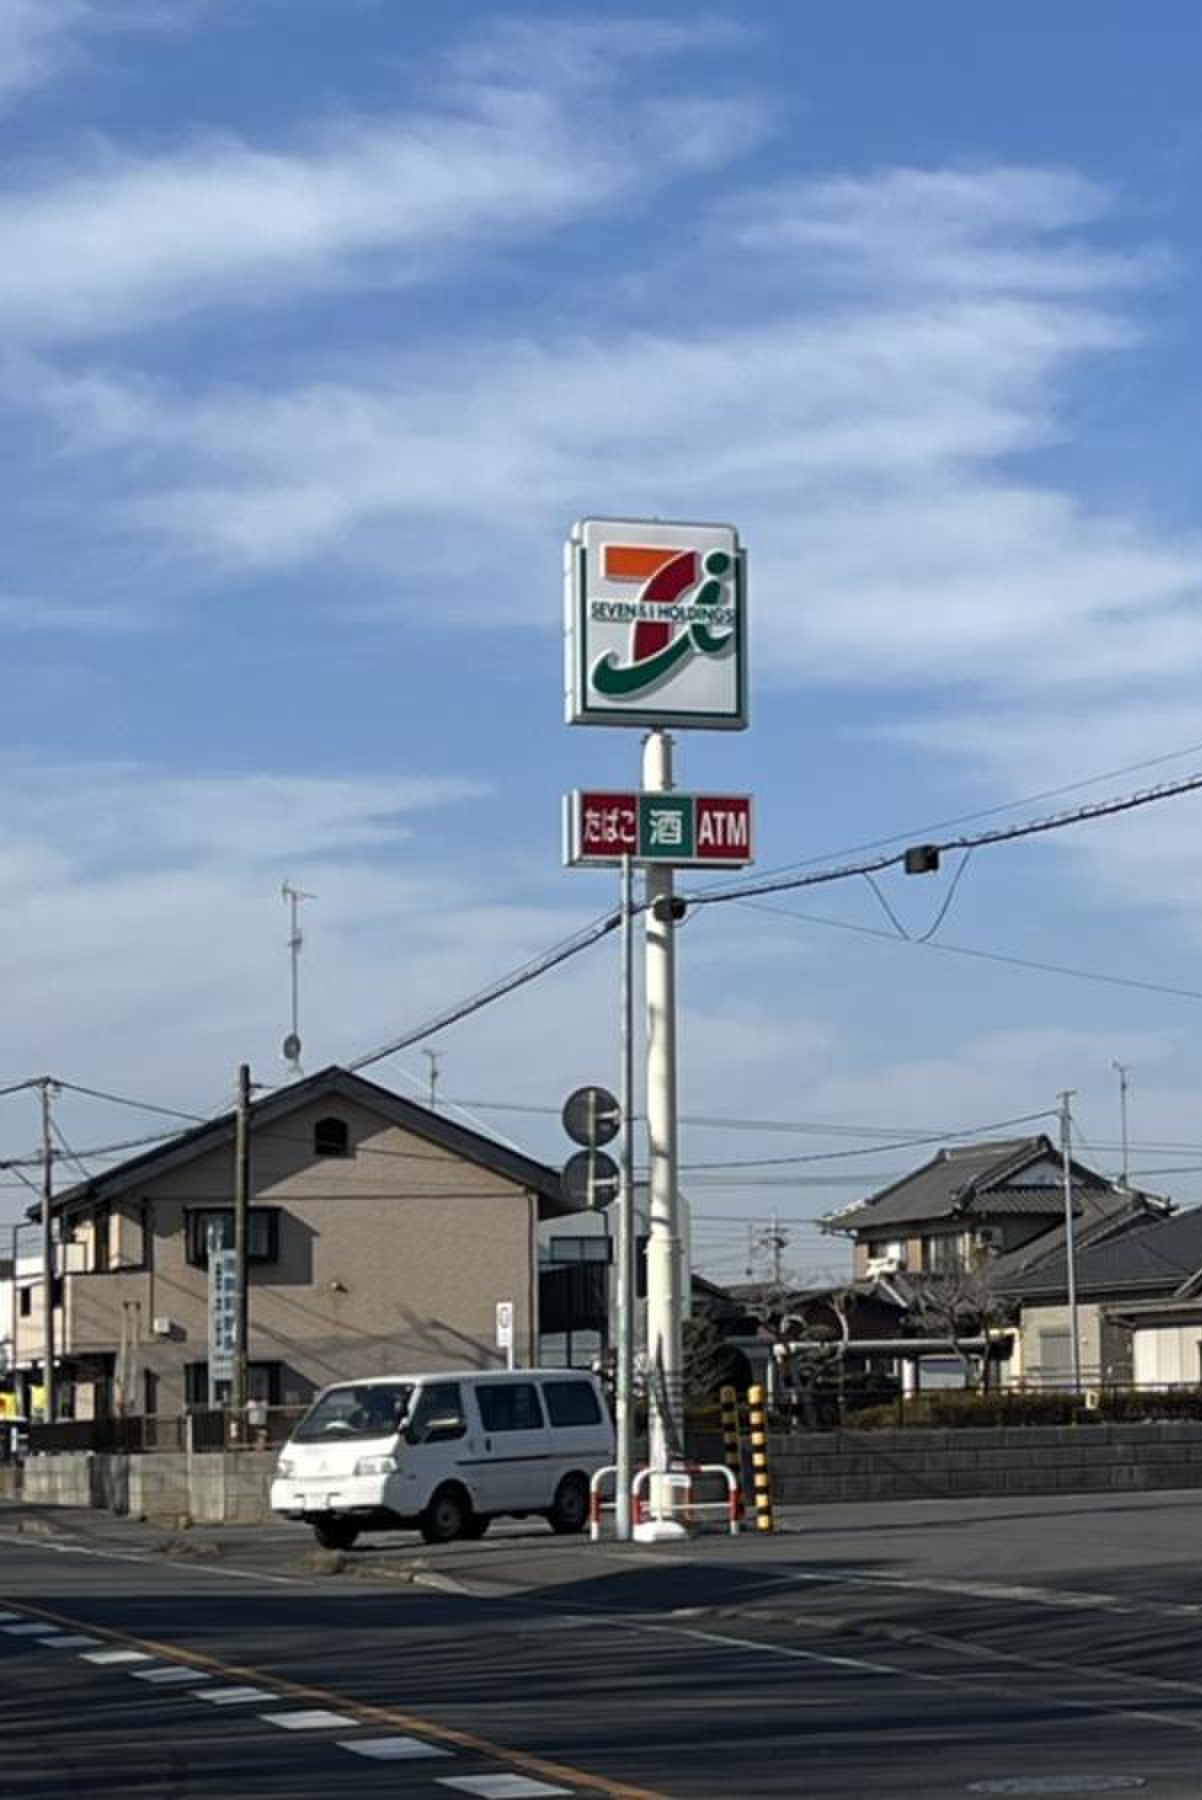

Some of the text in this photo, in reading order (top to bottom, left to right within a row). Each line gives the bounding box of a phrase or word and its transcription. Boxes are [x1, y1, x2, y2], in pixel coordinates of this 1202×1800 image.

[584, 808, 636, 842] たばこ
[649, 809, 683, 845] 酒
[698, 811, 748, 846] ATM
